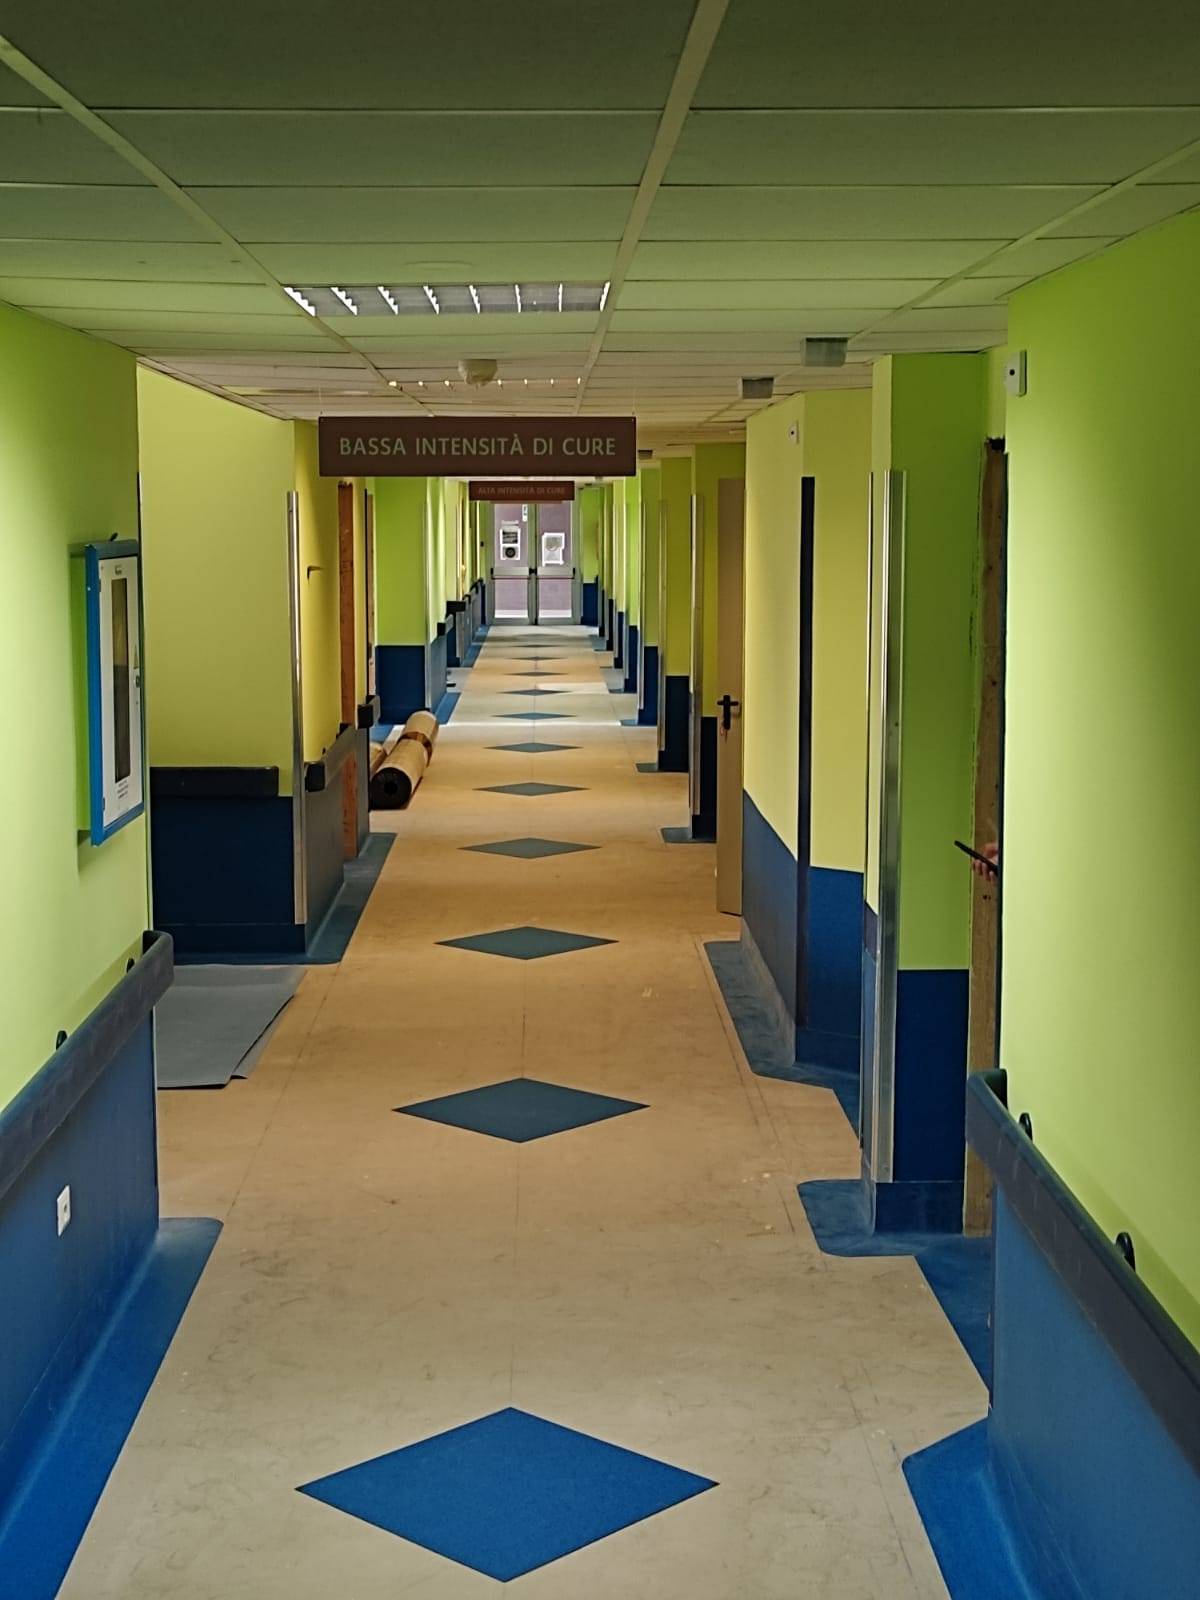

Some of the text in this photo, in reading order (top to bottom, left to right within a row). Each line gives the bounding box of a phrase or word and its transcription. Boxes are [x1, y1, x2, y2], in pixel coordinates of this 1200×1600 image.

[339, 433, 616, 456] BASSA INTENSITÀ DI CURE
[478, 487, 496, 495] ALTA
[536, 487, 545, 495] DI
[546, 487, 565, 495] CURE
